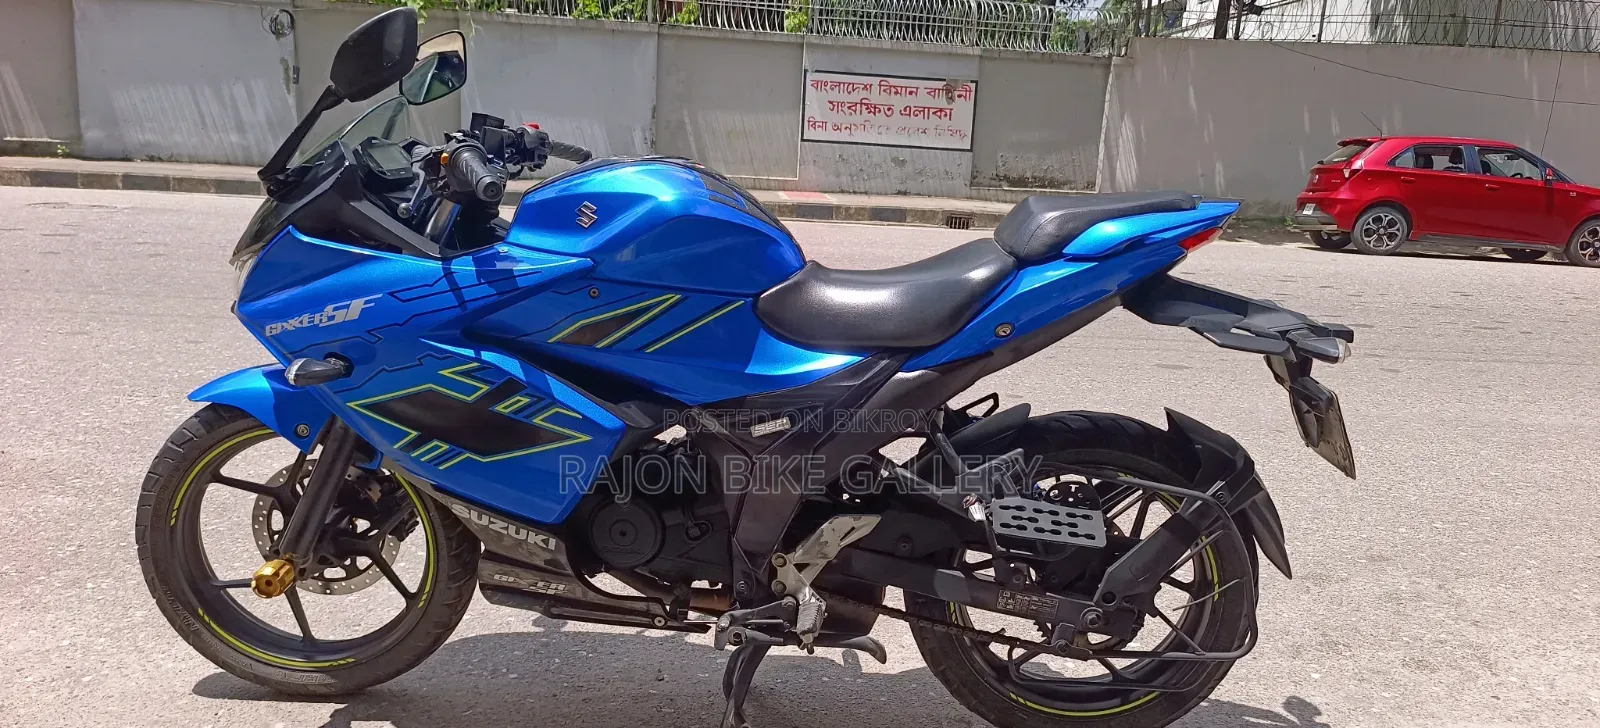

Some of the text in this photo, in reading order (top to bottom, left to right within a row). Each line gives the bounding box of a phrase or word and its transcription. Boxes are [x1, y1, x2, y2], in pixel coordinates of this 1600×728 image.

[810, 79, 973, 103] বাংলাদেশ বিমান বাহিনী
[828, 97, 954, 121] সংরক্ষিত এলাকা
[806, 116, 828, 132] বিনা
[450, 503, 557, 551] SUZUKI
